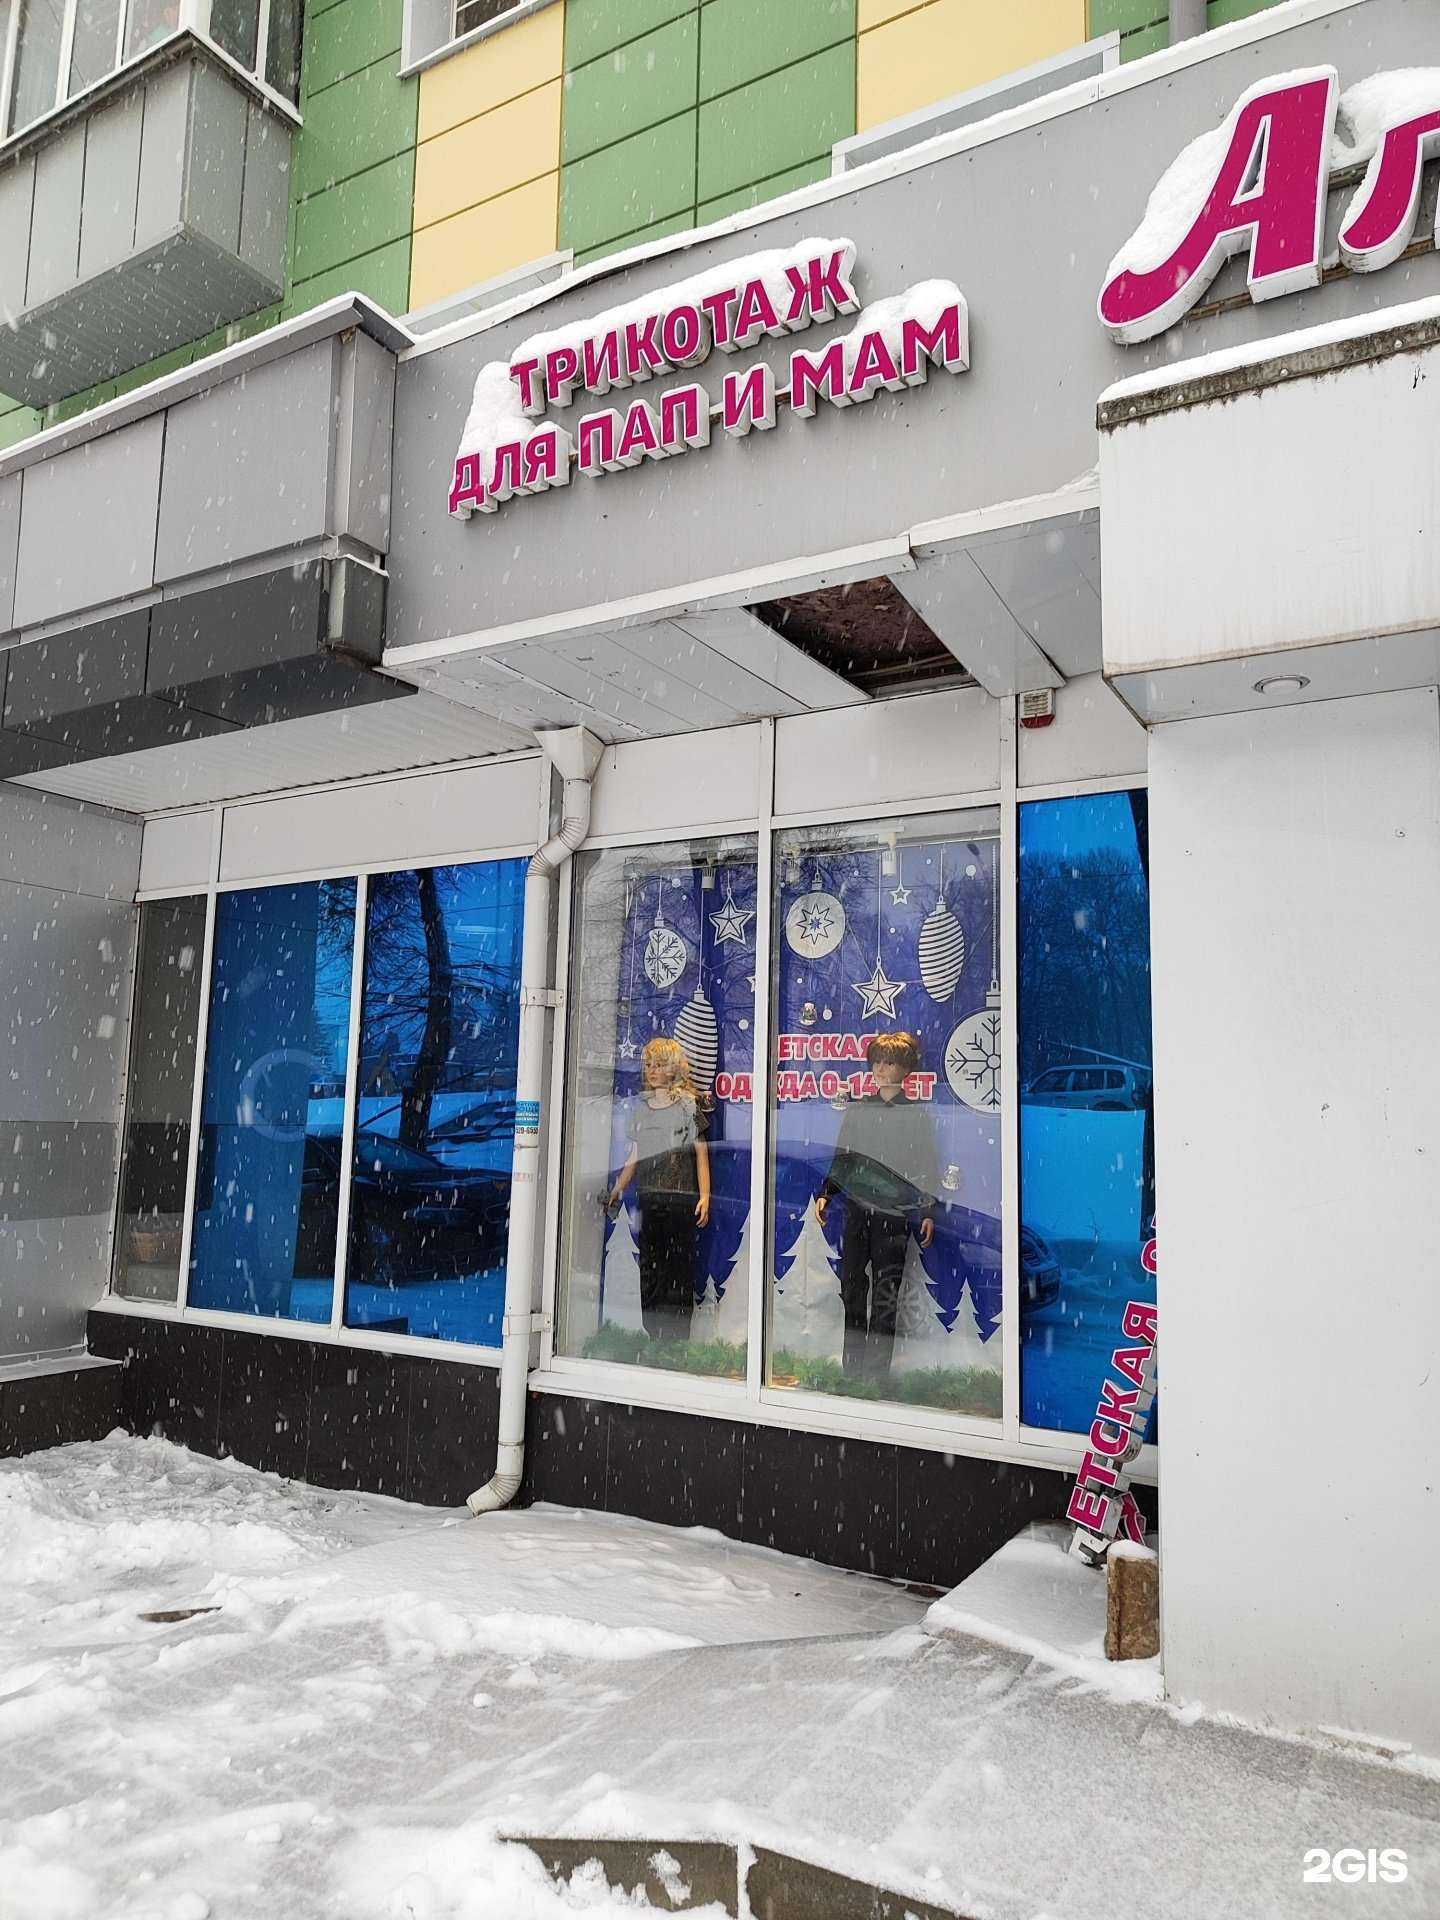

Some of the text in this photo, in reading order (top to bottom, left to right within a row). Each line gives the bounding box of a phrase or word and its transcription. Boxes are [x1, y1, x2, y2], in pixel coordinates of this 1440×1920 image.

[447, 301, 962, 515] ДЛЯ ПАП И МАМ
[509, 248, 852, 411] ТРИКОТАЖ
[777, 1033, 878, 1061] ЕТСКАЯ
